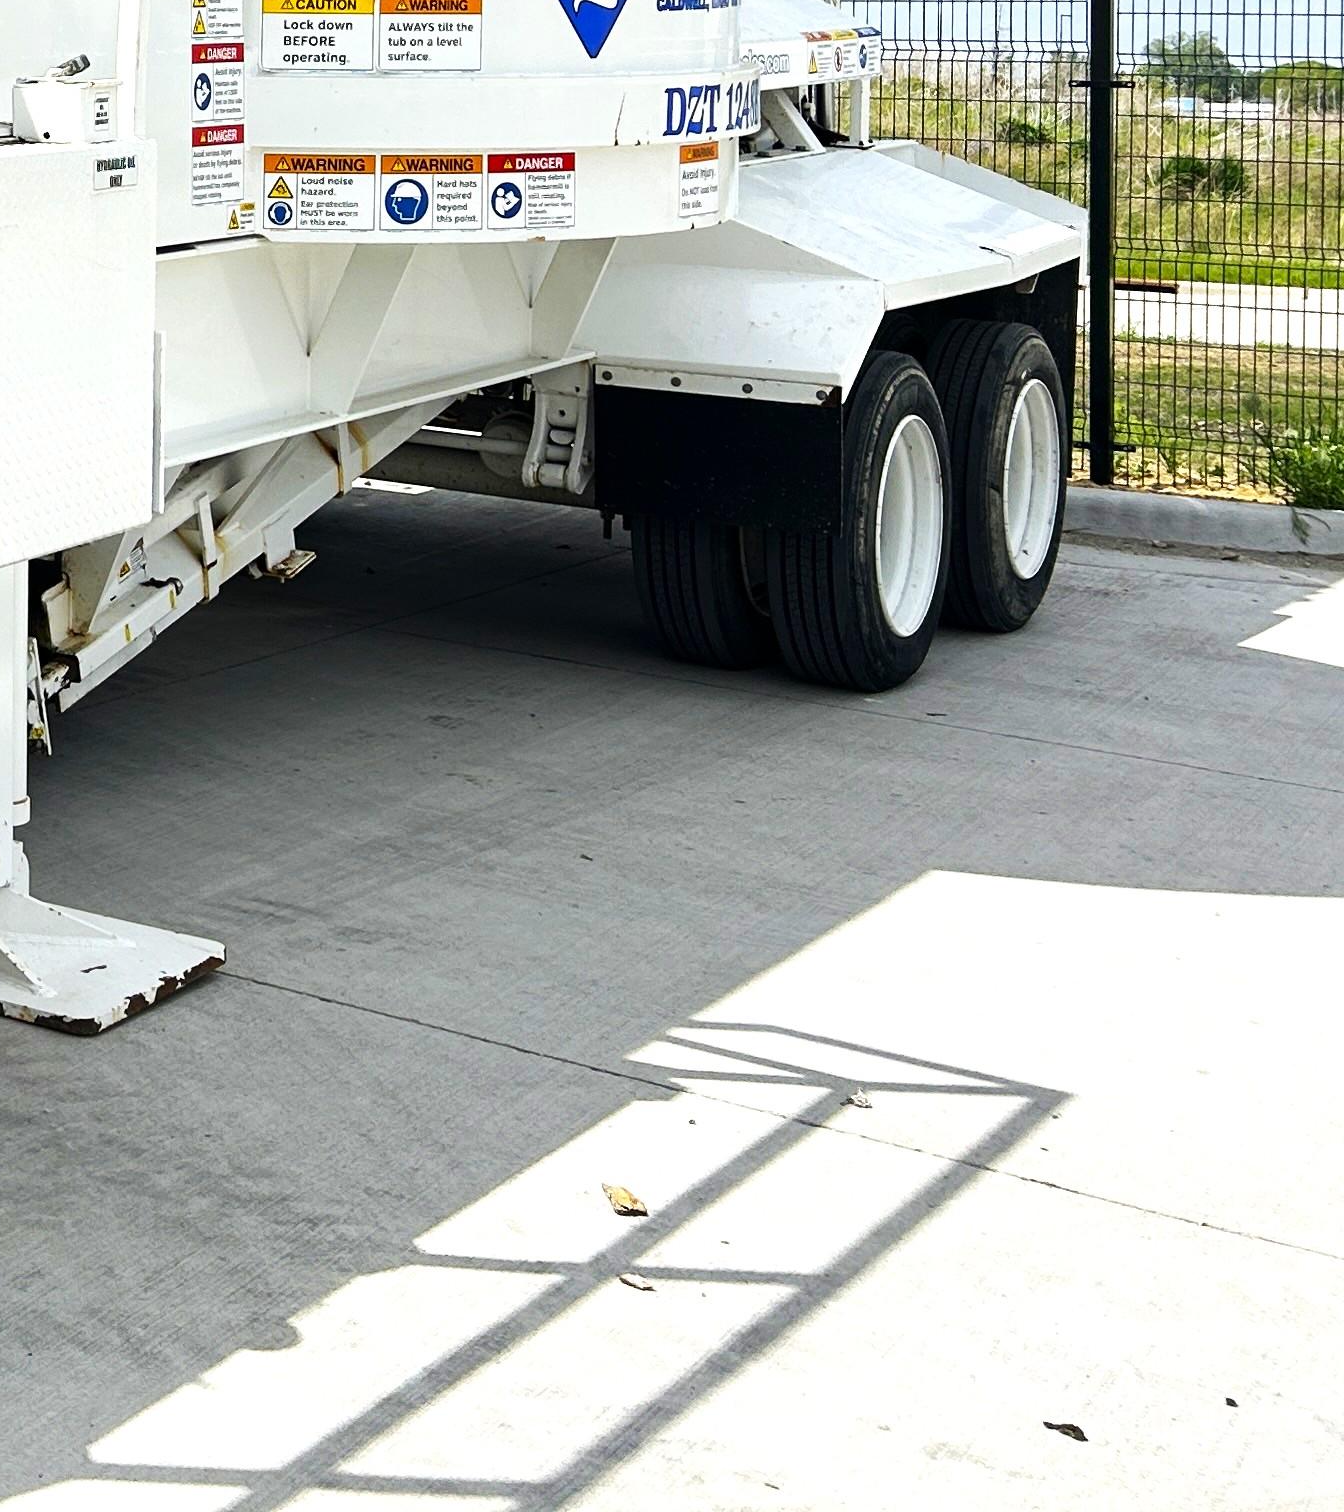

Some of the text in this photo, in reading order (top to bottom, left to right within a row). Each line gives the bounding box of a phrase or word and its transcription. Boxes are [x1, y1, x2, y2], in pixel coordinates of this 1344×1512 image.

[409, 0, 468, 11] WARNING
[284, 20, 353, 30] Lock down
[388, 22, 474, 31] ALWAYS tilt the
[284, 36, 336, 46] BEFORE
[388, 37, 406, 46] tub
[437, 37, 462, 46] level
[207, 47, 237, 60] DANGER
[283, 52, 350, 65] operating.
[388, 51, 432, 61] surface.
[663, 84, 721, 137] DZT
[207, 129, 237, 143] DANGER
[291, 158, 365, 171] WARNING
[406, 158, 473, 171] WARNING
[515, 157, 563, 170] DANGER
[301, 177, 354, 185] Loud noise
[437, 180, 477, 188] Hard hats
[301, 188, 336, 196] hazard.
[437, 192, 472, 200] required
[437, 203, 467, 212] beyond
